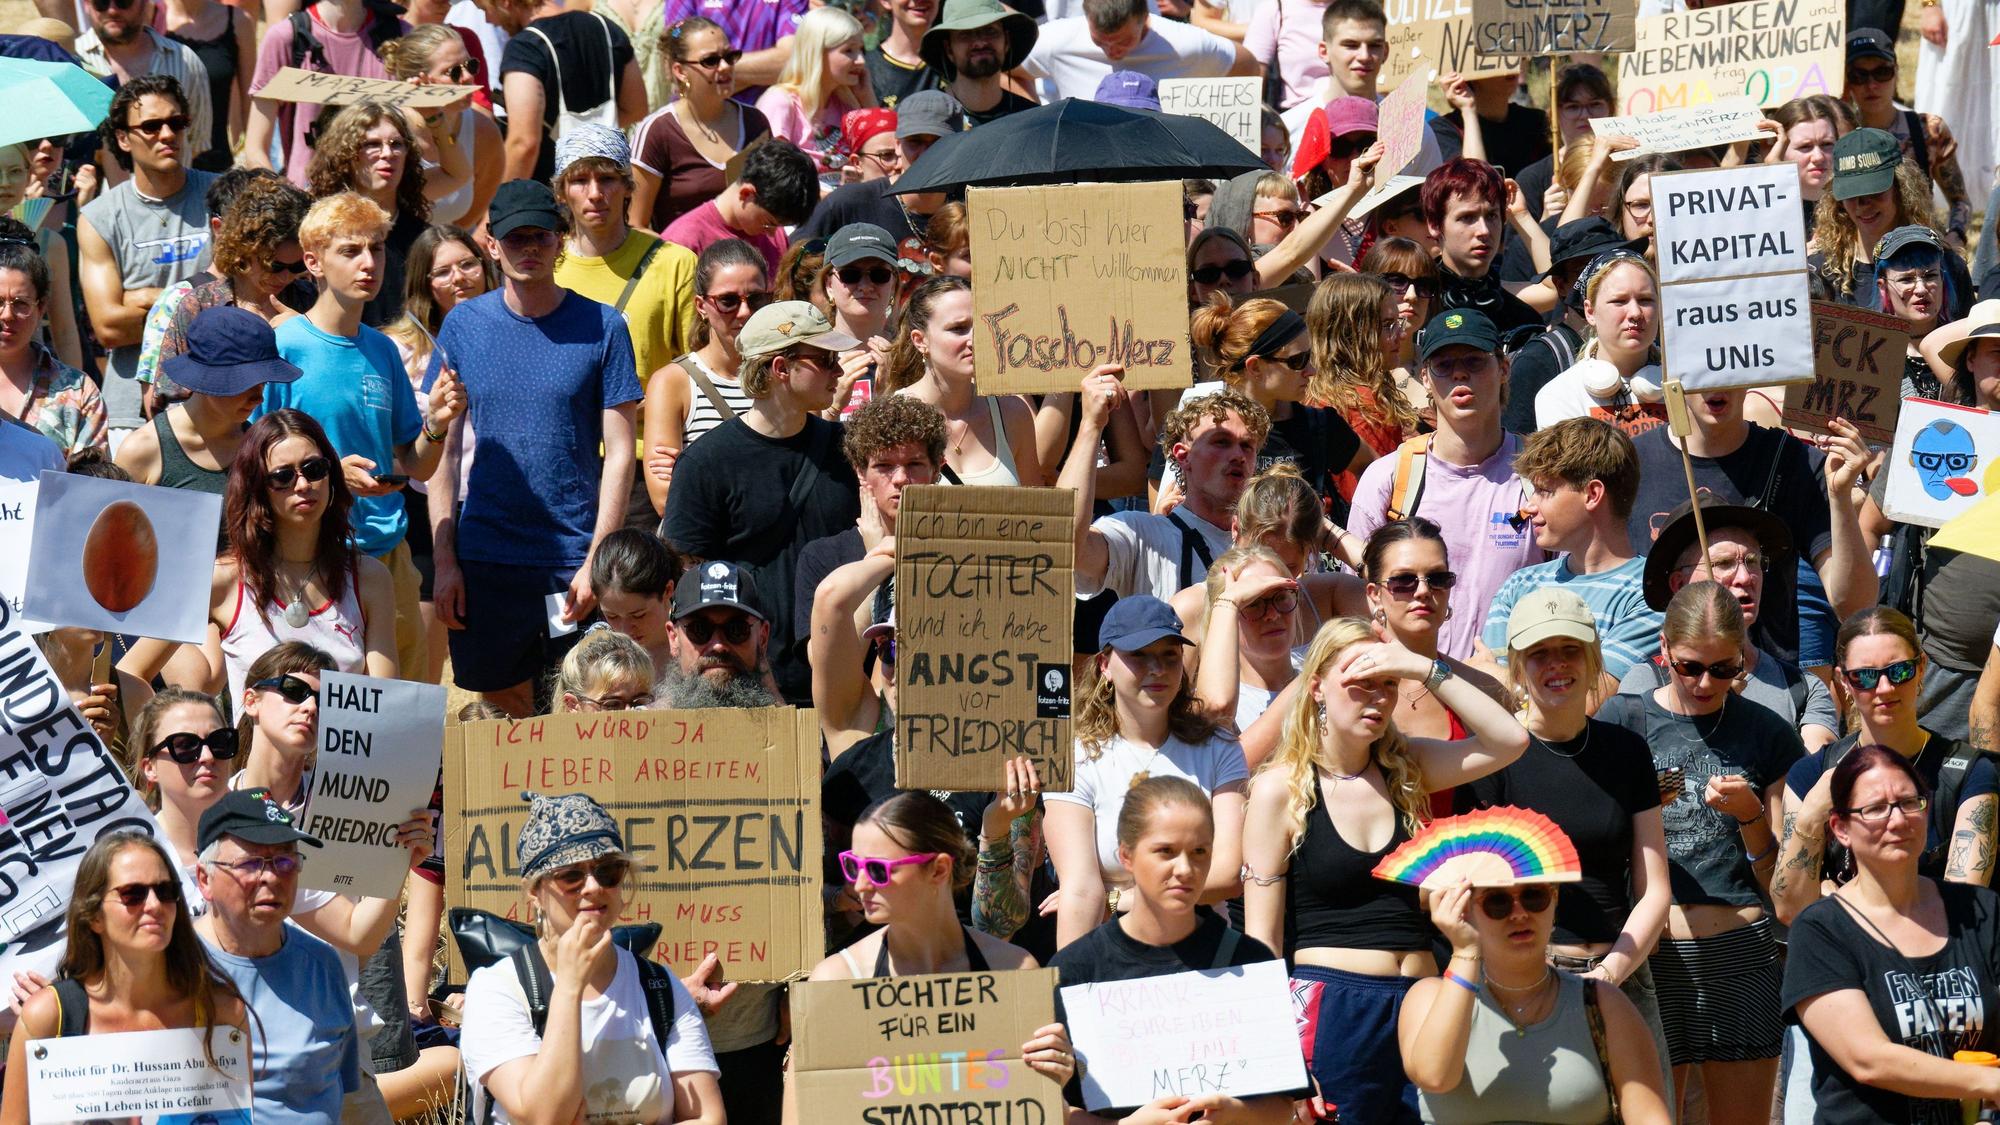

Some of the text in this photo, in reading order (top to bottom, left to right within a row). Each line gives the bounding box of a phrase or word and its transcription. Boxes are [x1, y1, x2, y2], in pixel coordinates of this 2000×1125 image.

[1476, 13, 1614, 53] (SCH)MERZ
[1664, 0, 1800, 41] RISIKEN
[1808, 2, 1838, 17] und
[1390, 27, 1424, 49] außer
[1622, 20, 1842, 78] NEBENWIRKUNGEN
[1627, 79, 1713, 116] OMA
[1745, 62, 1829, 106] OPA
[1713, 65, 1746, 84] frag
[1171, 82, 1255, 108] FISCHERS
[1669, 184, 1786, 217] PRIVAT-
[987, 208, 1153, 247] Du bist hier
[1671, 231, 1794, 265] KAPITAL
[994, 254, 1078, 284] NICHT
[1676, 297, 1797, 327] raus aus
[981, 303, 1176, 374] Fascho-Merz
[1815, 319, 1887, 374] FCK
[1706, 344, 1775, 372] UNIs
[1802, 374, 1881, 422] MRZ
[909, 499, 1044, 544] Ich bin eine
[902, 552, 1060, 601] TOCHTER
[909, 608, 1052, 643] und ich habe
[908, 650, 1039, 692] ANGST
[327, 682, 383, 713] HALT
[959, 691, 1001, 713] vor
[325, 727, 372, 758] DEN
[495, 719, 544, 747] ICH
[671, 721, 705, 745] JA
[901, 713, 1059, 757] FRIEDRICH
[318, 771, 390, 803] MUND
[503, 757, 615, 790] LIEBER
[309, 814, 409, 849] FRIEDRIC
[333, 874, 354, 886] BITTE
[676, 903, 743, 924] MUSS
[852, 974, 998, 1010] TÖCHTER
[878, 1012, 976, 1041] FÜR EIN
[40, 1055, 237, 1080] Freiheit für Dr. Hussam Abu afiya
[862, 1048, 1009, 1098] BUNTES
[1152, 1062, 1232, 1099] MERZ
[75, 1095, 213, 1114] Sein Leben ist in Gefahr
[862, 1097, 1046, 1125] STADTBILD
